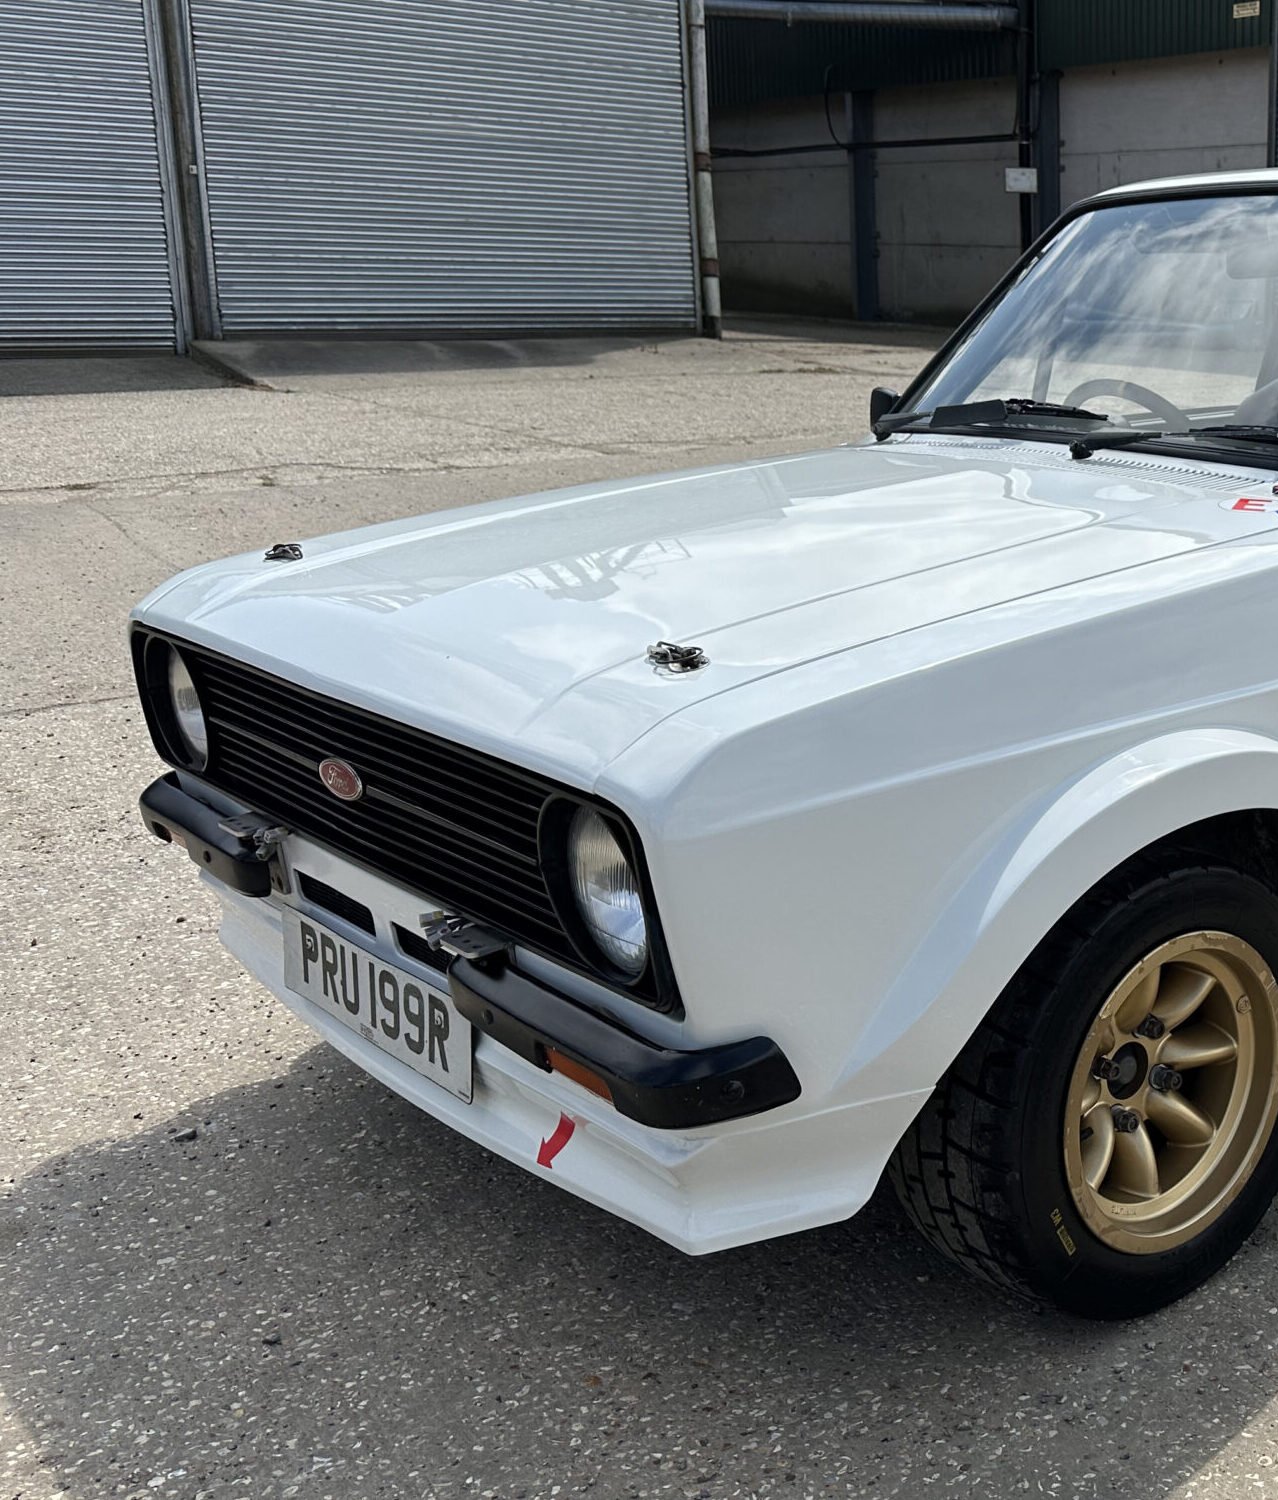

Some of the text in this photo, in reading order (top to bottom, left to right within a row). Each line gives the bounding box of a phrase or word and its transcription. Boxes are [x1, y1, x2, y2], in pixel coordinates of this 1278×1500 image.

[1231, 498, 1273, 512] E
[300, 919, 450, 1073] PRU 199R
